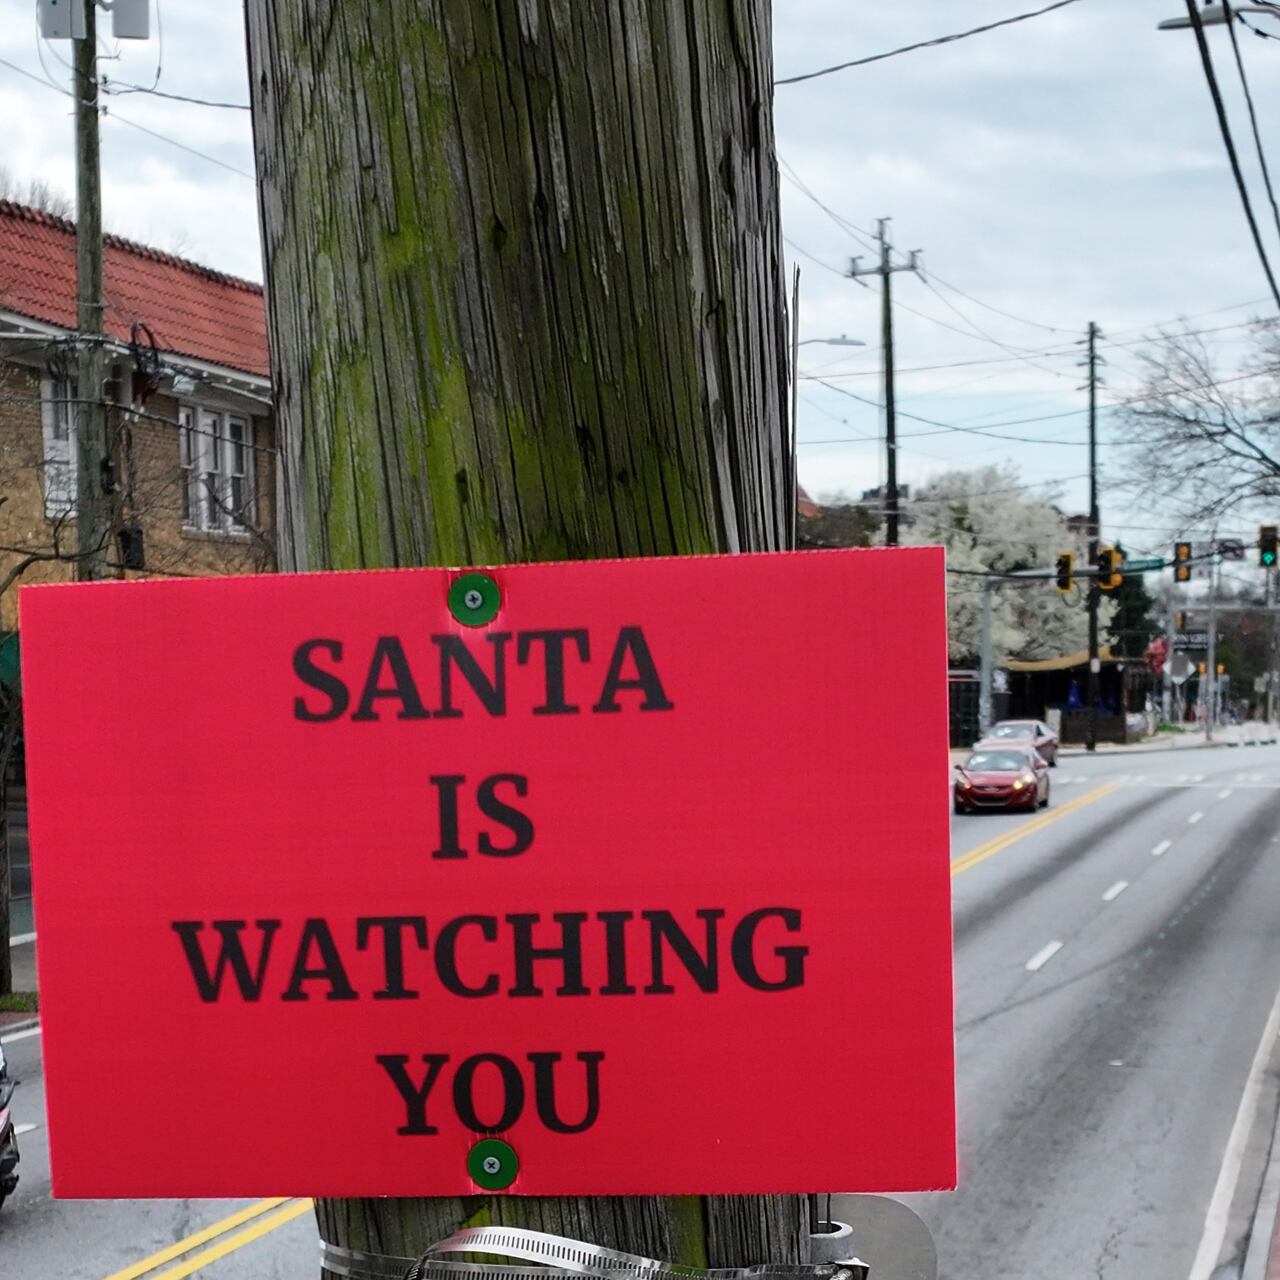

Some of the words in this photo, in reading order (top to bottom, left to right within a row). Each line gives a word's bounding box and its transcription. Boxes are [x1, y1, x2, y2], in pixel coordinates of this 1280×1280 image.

[294, 625, 673, 722] SANTA
[431, 774, 533, 858] IS
[172, 908, 808, 1002] WATCHING
[377, 1052, 604, 1136] YOU
